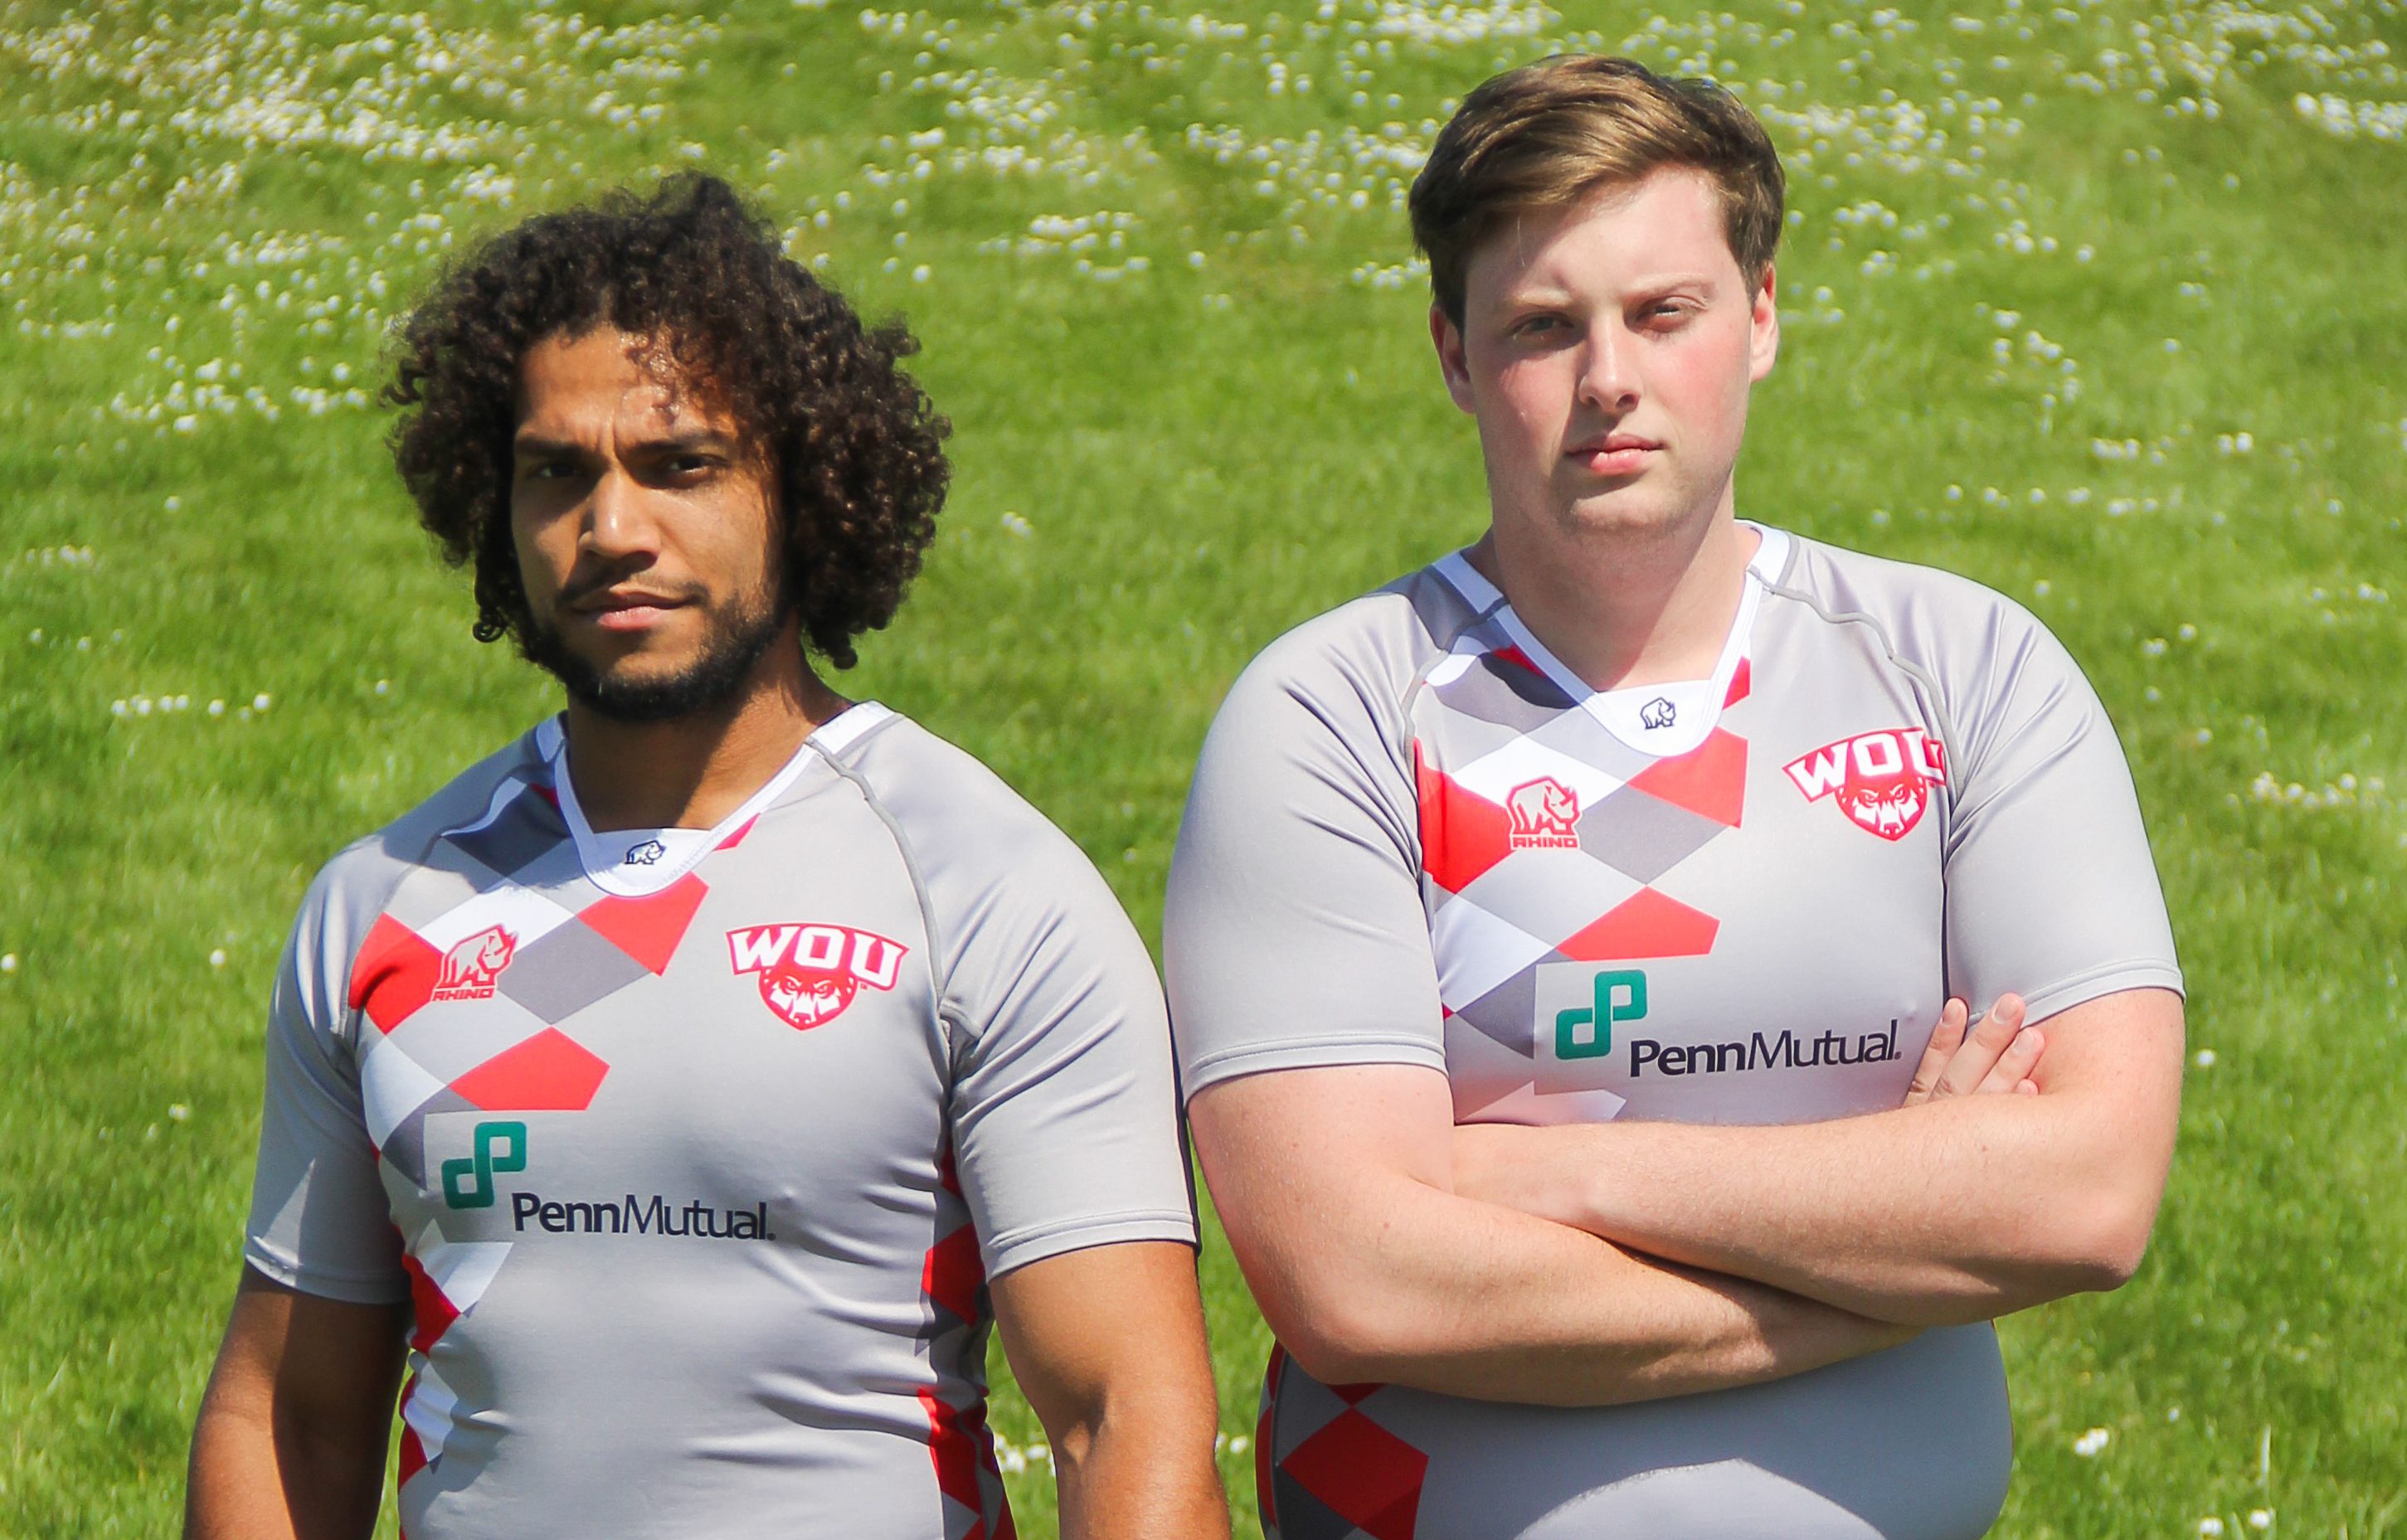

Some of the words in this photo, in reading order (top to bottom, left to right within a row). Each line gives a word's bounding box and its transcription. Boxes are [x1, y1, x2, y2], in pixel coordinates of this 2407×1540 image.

[1512, 836, 1578, 848] RHINO
[730, 925, 904, 988] WOU
[432, 987, 496, 1002] RHINO
